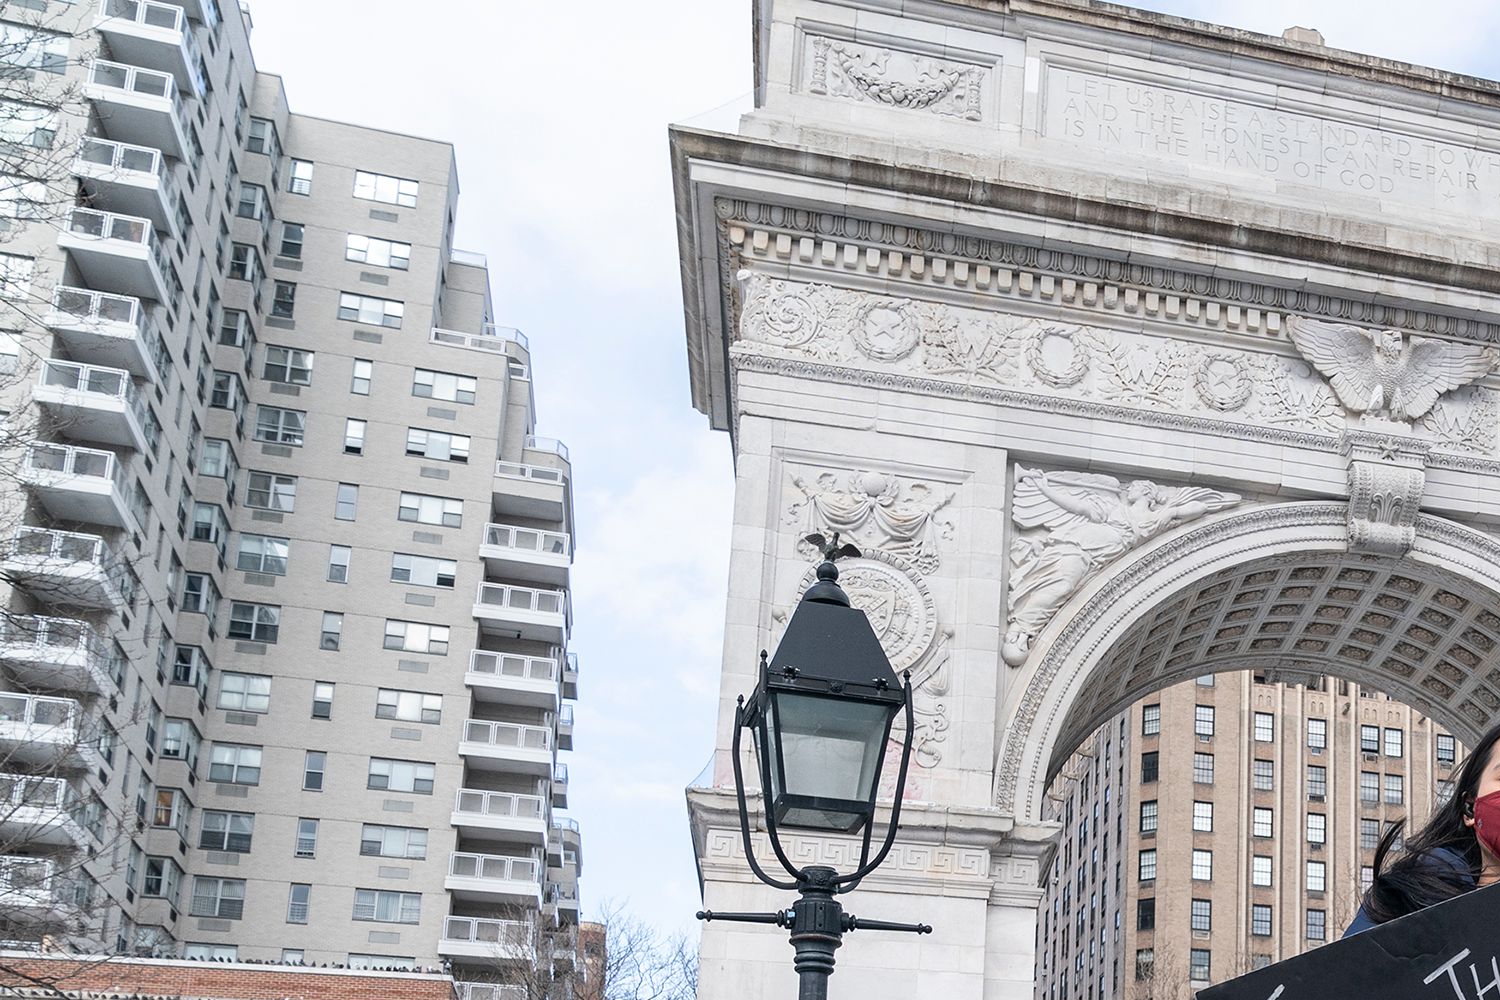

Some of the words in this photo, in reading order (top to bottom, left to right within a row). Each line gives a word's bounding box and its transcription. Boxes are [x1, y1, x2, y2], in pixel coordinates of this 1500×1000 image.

[1063, 97, 1118, 122] AND
[1130, 108, 1185, 135] THE
[1201, 122, 1308, 157] HONEST
[1324, 146, 1379, 170] CAN
[1393, 158, 1480, 191] REPAIR
[1064, 118, 1085, 137] IS
[1098, 124, 1122, 145] IN
[1134, 130, 1189, 157] THE
[1204, 143, 1279, 173] HAND
[1293, 161, 1327, 181] OF
[1340, 169, 1394, 193] GOD
[1065, 76, 1117, 101] LET
[1126, 87, 1154, 108] US
[1163, 94, 1237, 124] RAISE
[1248, 111, 1264, 130] A
[1276, 116, 1411, 157] STANDARD
[1421, 144, 1455, 165] TO
